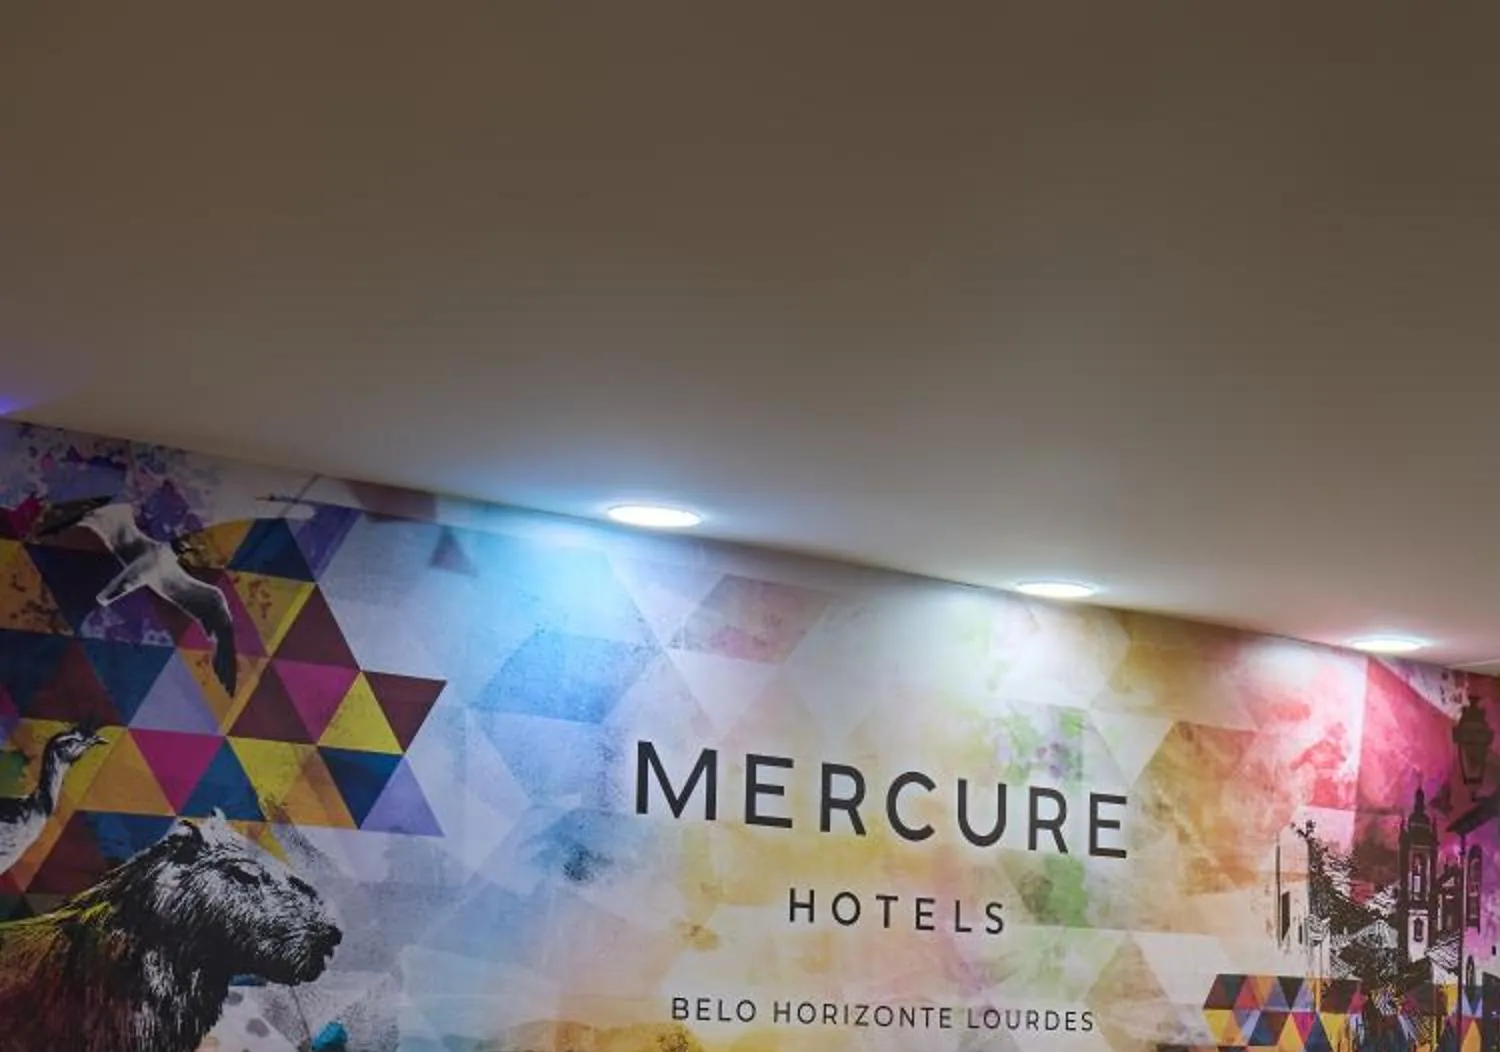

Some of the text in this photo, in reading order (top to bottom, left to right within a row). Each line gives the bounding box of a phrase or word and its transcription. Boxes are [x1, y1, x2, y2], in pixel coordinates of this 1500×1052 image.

[635, 740, 1128, 859] MERCURE
[789, 887, 1004, 935] HOTELS
[671, 997, 1094, 1033] BELO HORIZONTE LOURDES
